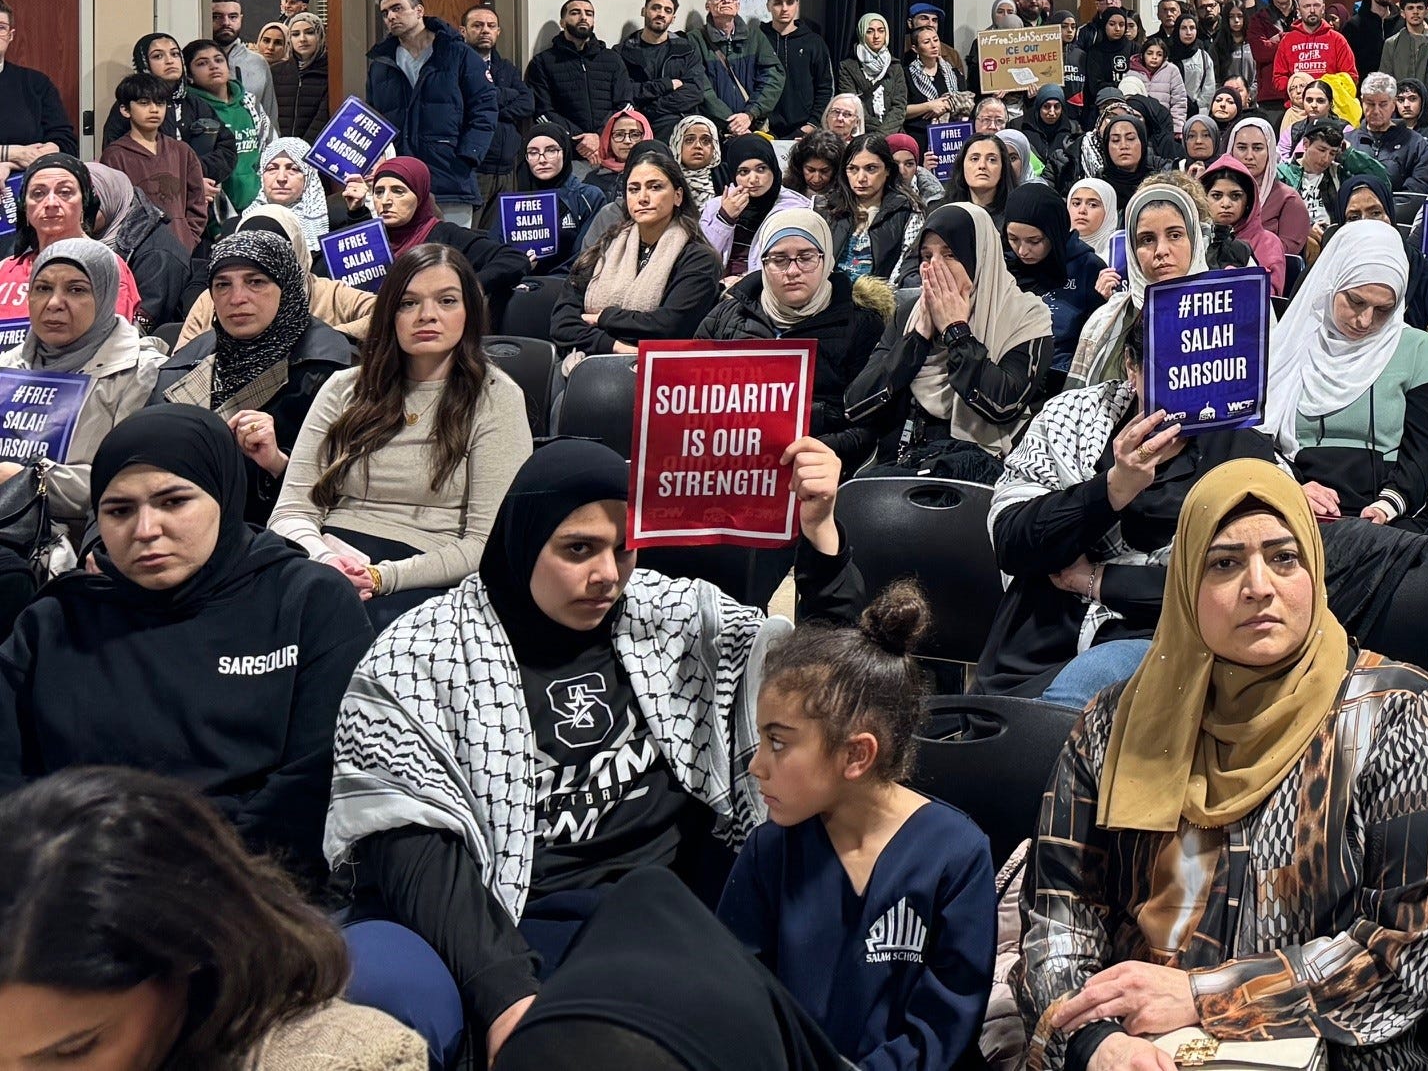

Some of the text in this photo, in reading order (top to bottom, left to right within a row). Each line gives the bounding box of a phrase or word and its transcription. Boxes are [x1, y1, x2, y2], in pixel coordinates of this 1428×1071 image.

[1005, 44, 1039, 55] ICE OUT
[1291, 42, 1329, 52] PATIENTS
[1298, 49, 1321, 60] OVER
[1000, 52, 1057, 65] OF MILWAUKEE
[1294, 61, 1327, 70] PROFITS
[352, 113, 382, 137] #FREE
[940, 129, 962, 139] #FREE
[342, 127, 373, 151] SALAH
[326, 136, 367, 168] SARSOUR
[938, 154, 958, 164] SARS
[514, 199, 542, 212] #FREE
[516, 214, 543, 227] SALAH
[338, 232, 368, 253] #FREE
[511, 228, 550, 242] SARSOUR
[342, 249, 375, 269] SALAH
[1178, 289, 1233, 319] #FREE
[1181, 323, 1234, 353] SALAH
[1168, 356, 1247, 391] SARSOUR
[11, 385, 58, 405] #FREE
[655, 382, 795, 415] SOLIDARITY
[3, 410, 48, 432] SALAH
[681, 428, 762, 457] IS OUR
[658, 469, 778, 497] STRENGTH
[217, 644, 299, 675] SARSOUR
[866, 951, 923, 963] SALAM SCHOOL
